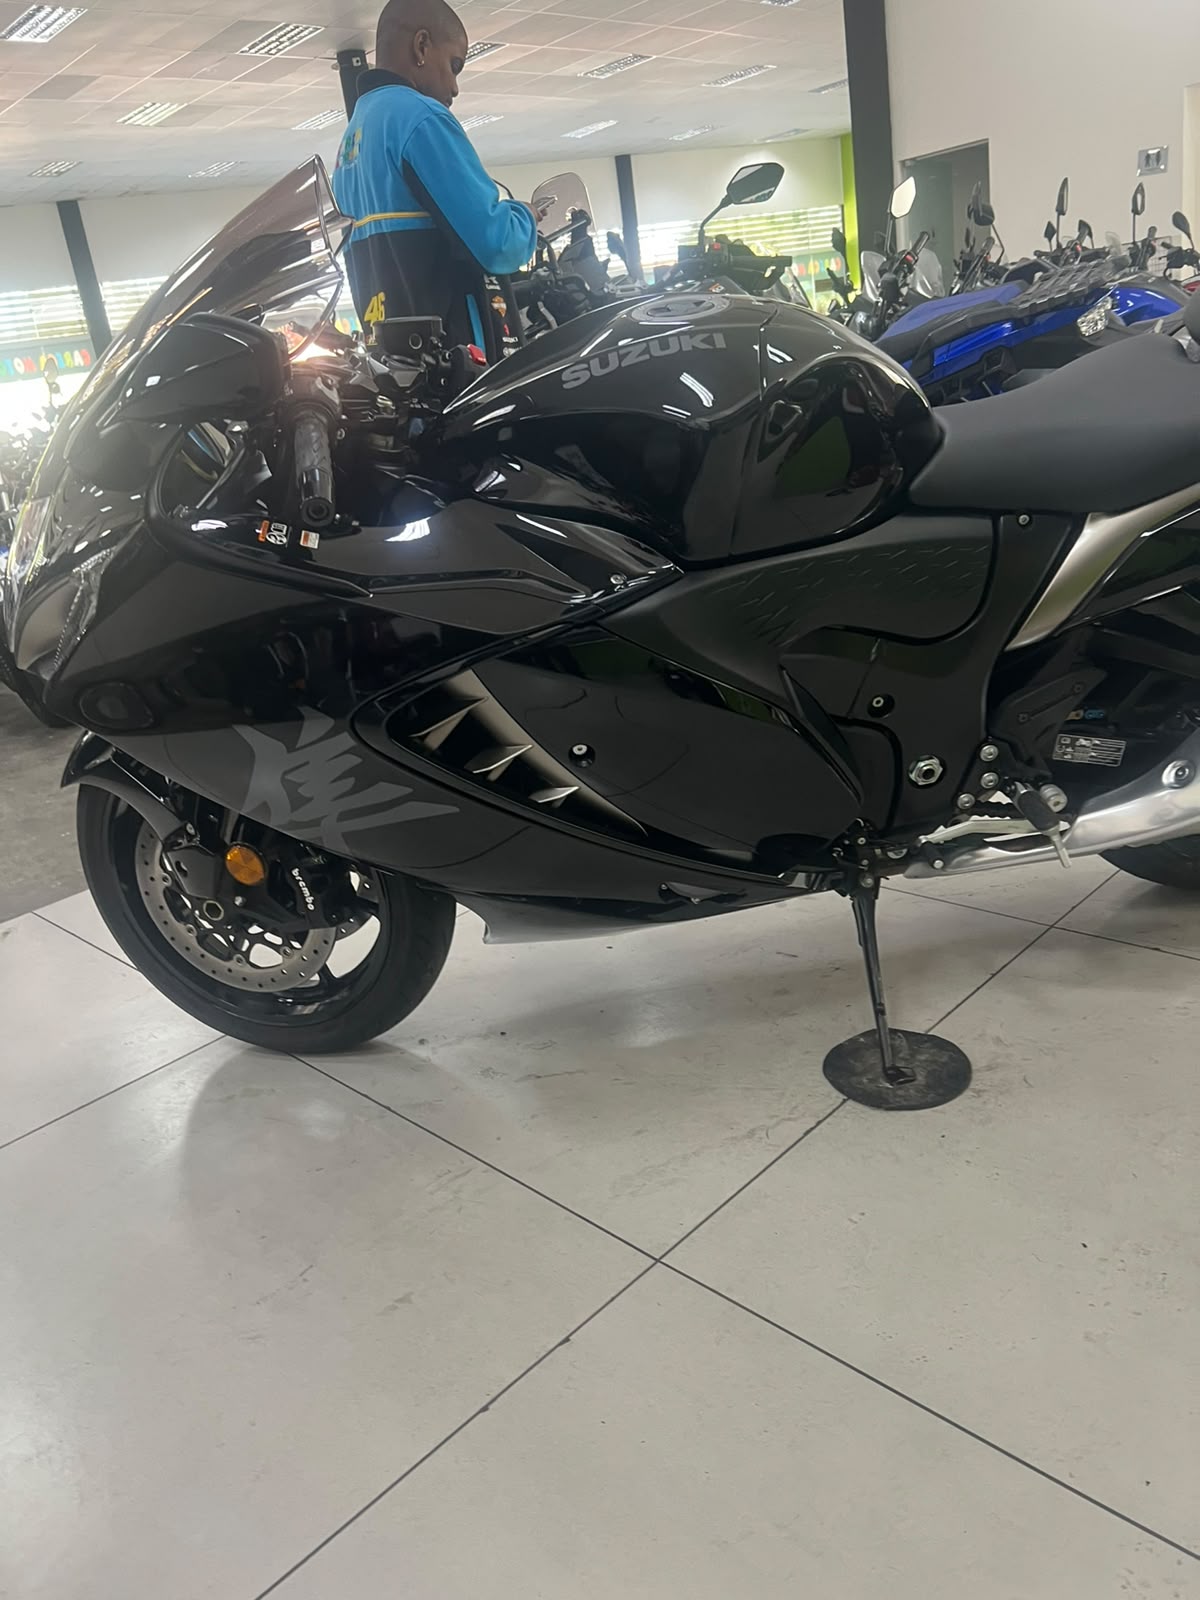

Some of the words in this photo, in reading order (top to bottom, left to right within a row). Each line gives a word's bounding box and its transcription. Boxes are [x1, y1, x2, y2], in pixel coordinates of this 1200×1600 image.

[364, 291, 386, 324] 46
[562, 332, 727, 390] SUZUKI
[291, 868, 315, 911] brembo
